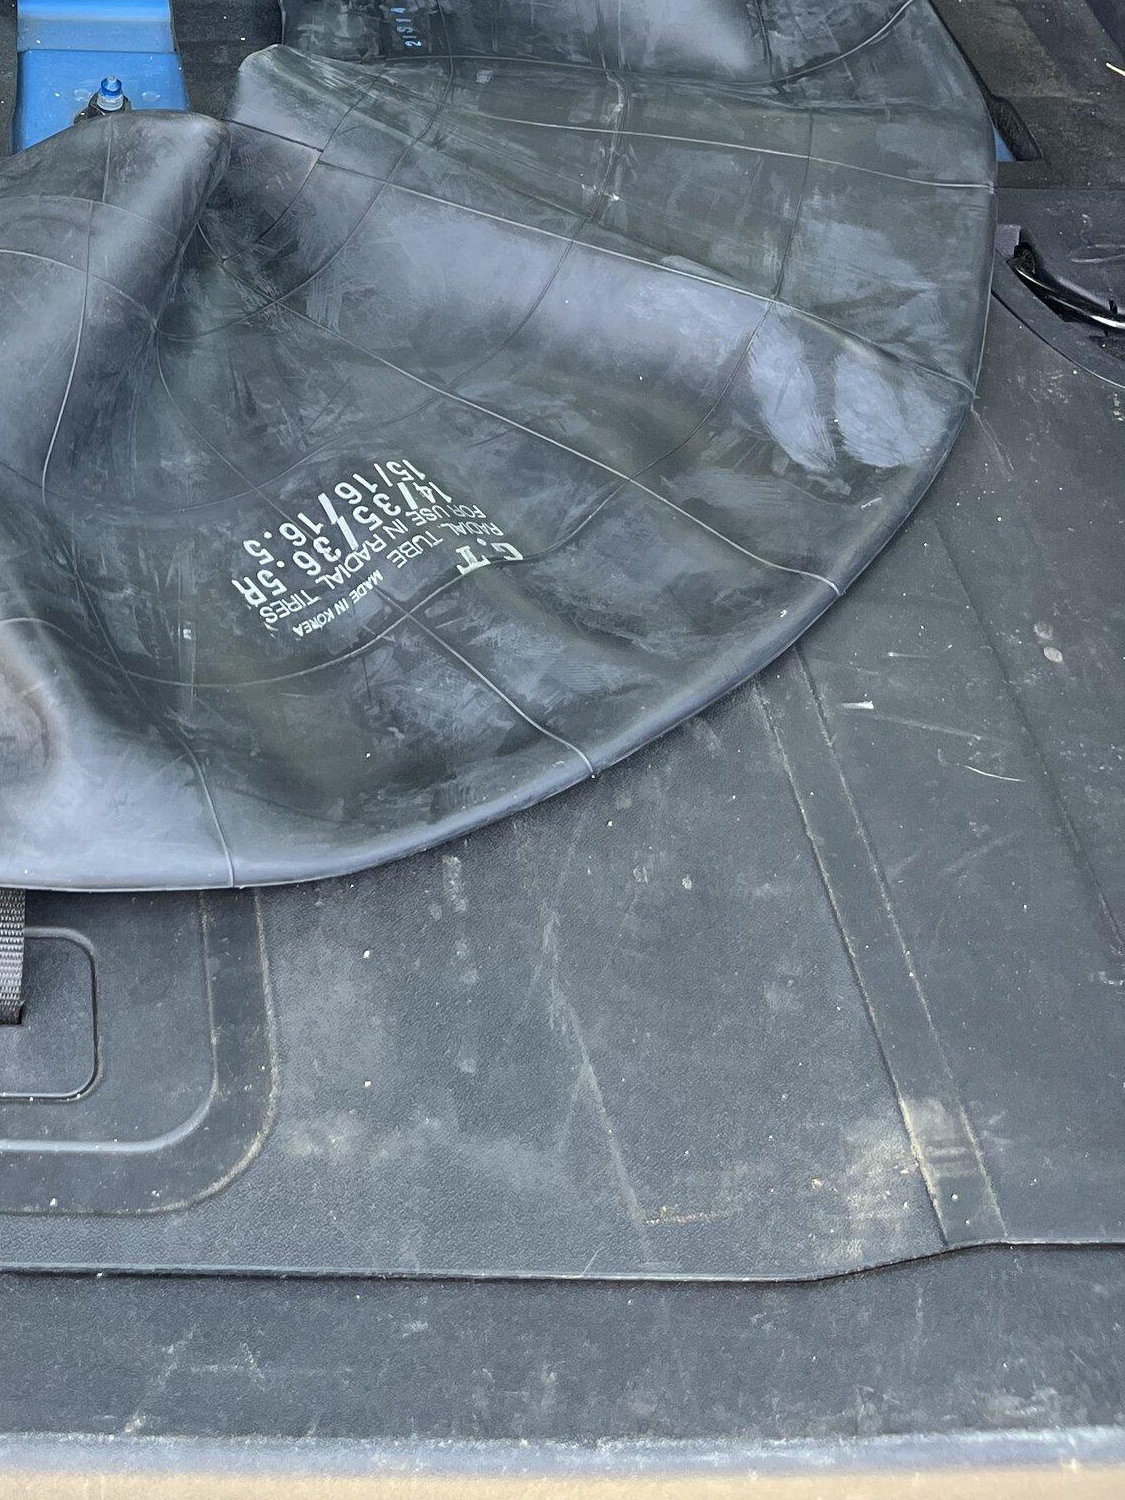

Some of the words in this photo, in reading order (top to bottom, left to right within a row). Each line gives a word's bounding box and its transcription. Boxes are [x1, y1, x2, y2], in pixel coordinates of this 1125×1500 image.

[405, 504, 451, 527] USE
[446, 504, 487, 519] FOR
[382, 518, 409, 540] IN
[439, 521, 505, 537] RADIAL
[315, 533, 387, 590] RADIAL
[386, 530, 444, 569] TUBE
[348, 569, 385, 604] MADE
[259, 589, 321, 624] TIRES
[333, 597, 350, 616] IN
[292, 608, 335, 637] KOREA
